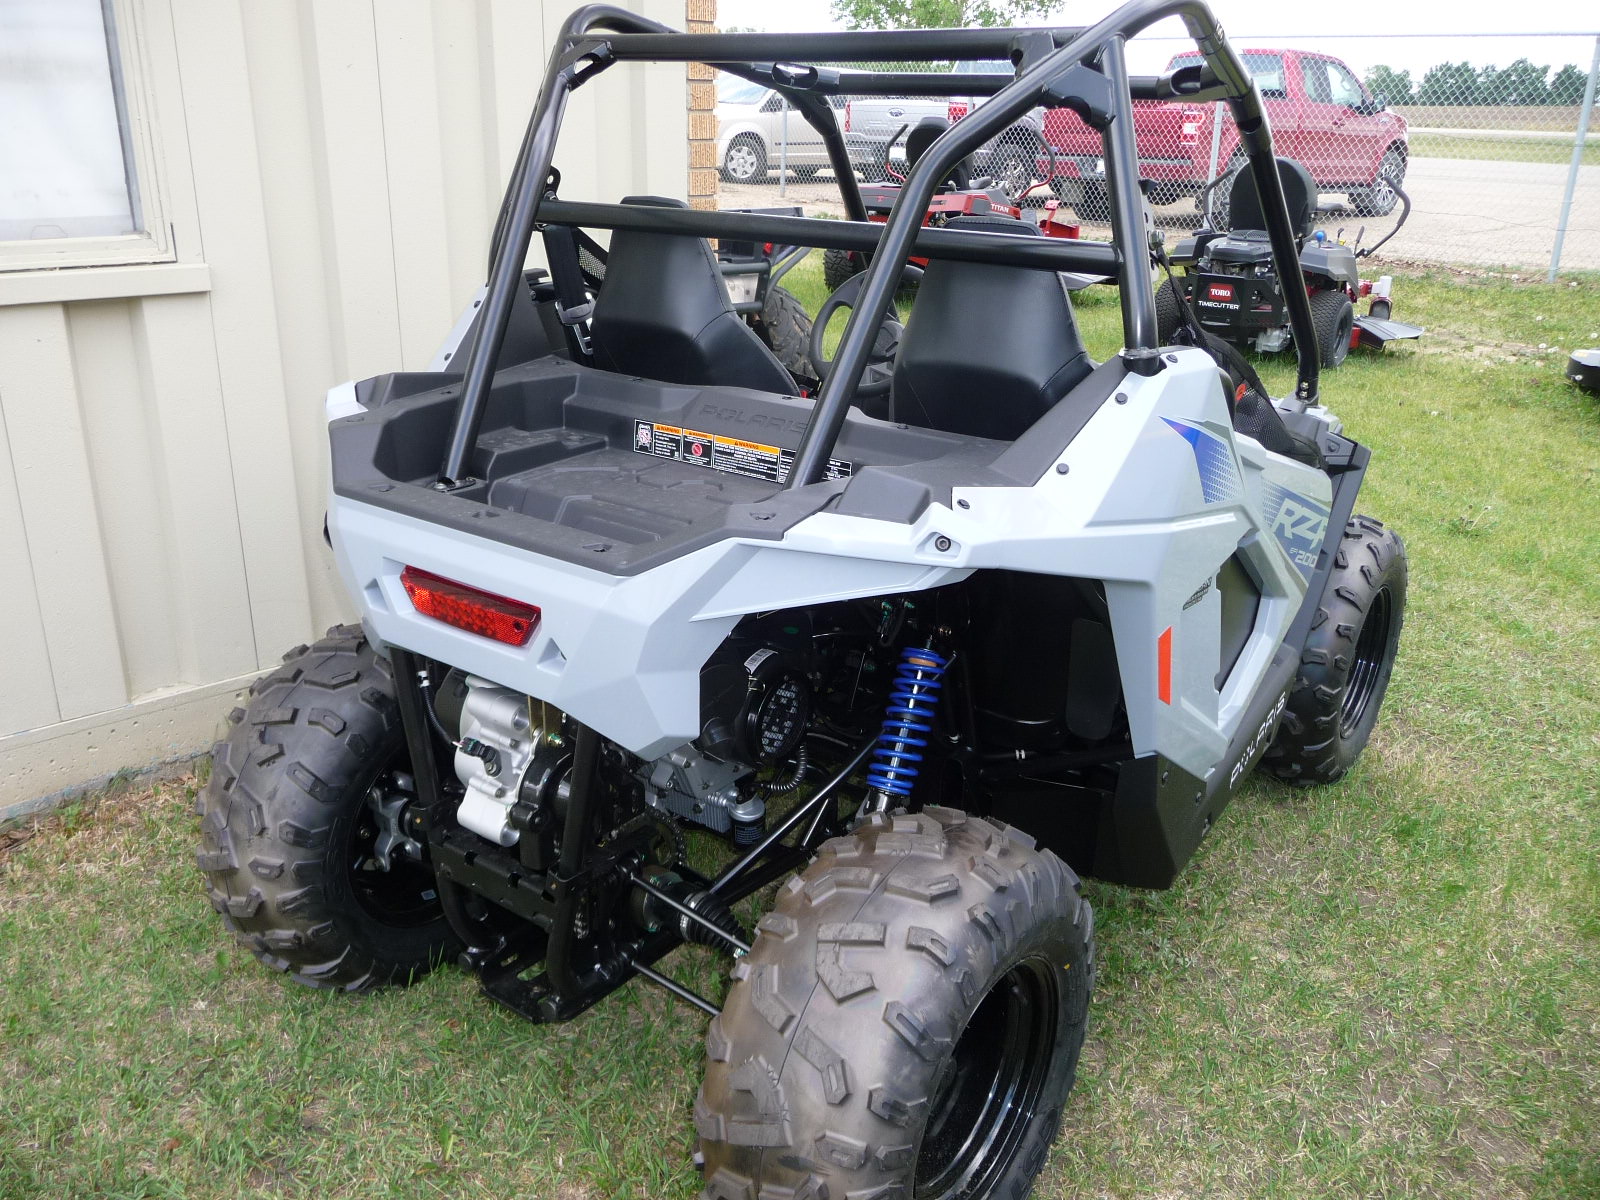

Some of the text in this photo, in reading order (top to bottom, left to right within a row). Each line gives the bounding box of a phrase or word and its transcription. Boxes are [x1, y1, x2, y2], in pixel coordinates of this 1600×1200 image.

[990, 203, 1010, 213] TITAN
[1210, 288, 1231, 296] TORO
[1198, 300, 1240, 310] TIMECUTTER
[699, 404, 806, 433] POLARIS
[661, 426, 680, 434] WARNING
[738, 442, 759, 450] WARNING
[1294, 550, 1318, 567] 200
[1229, 690, 1286, 790] POLARIS
